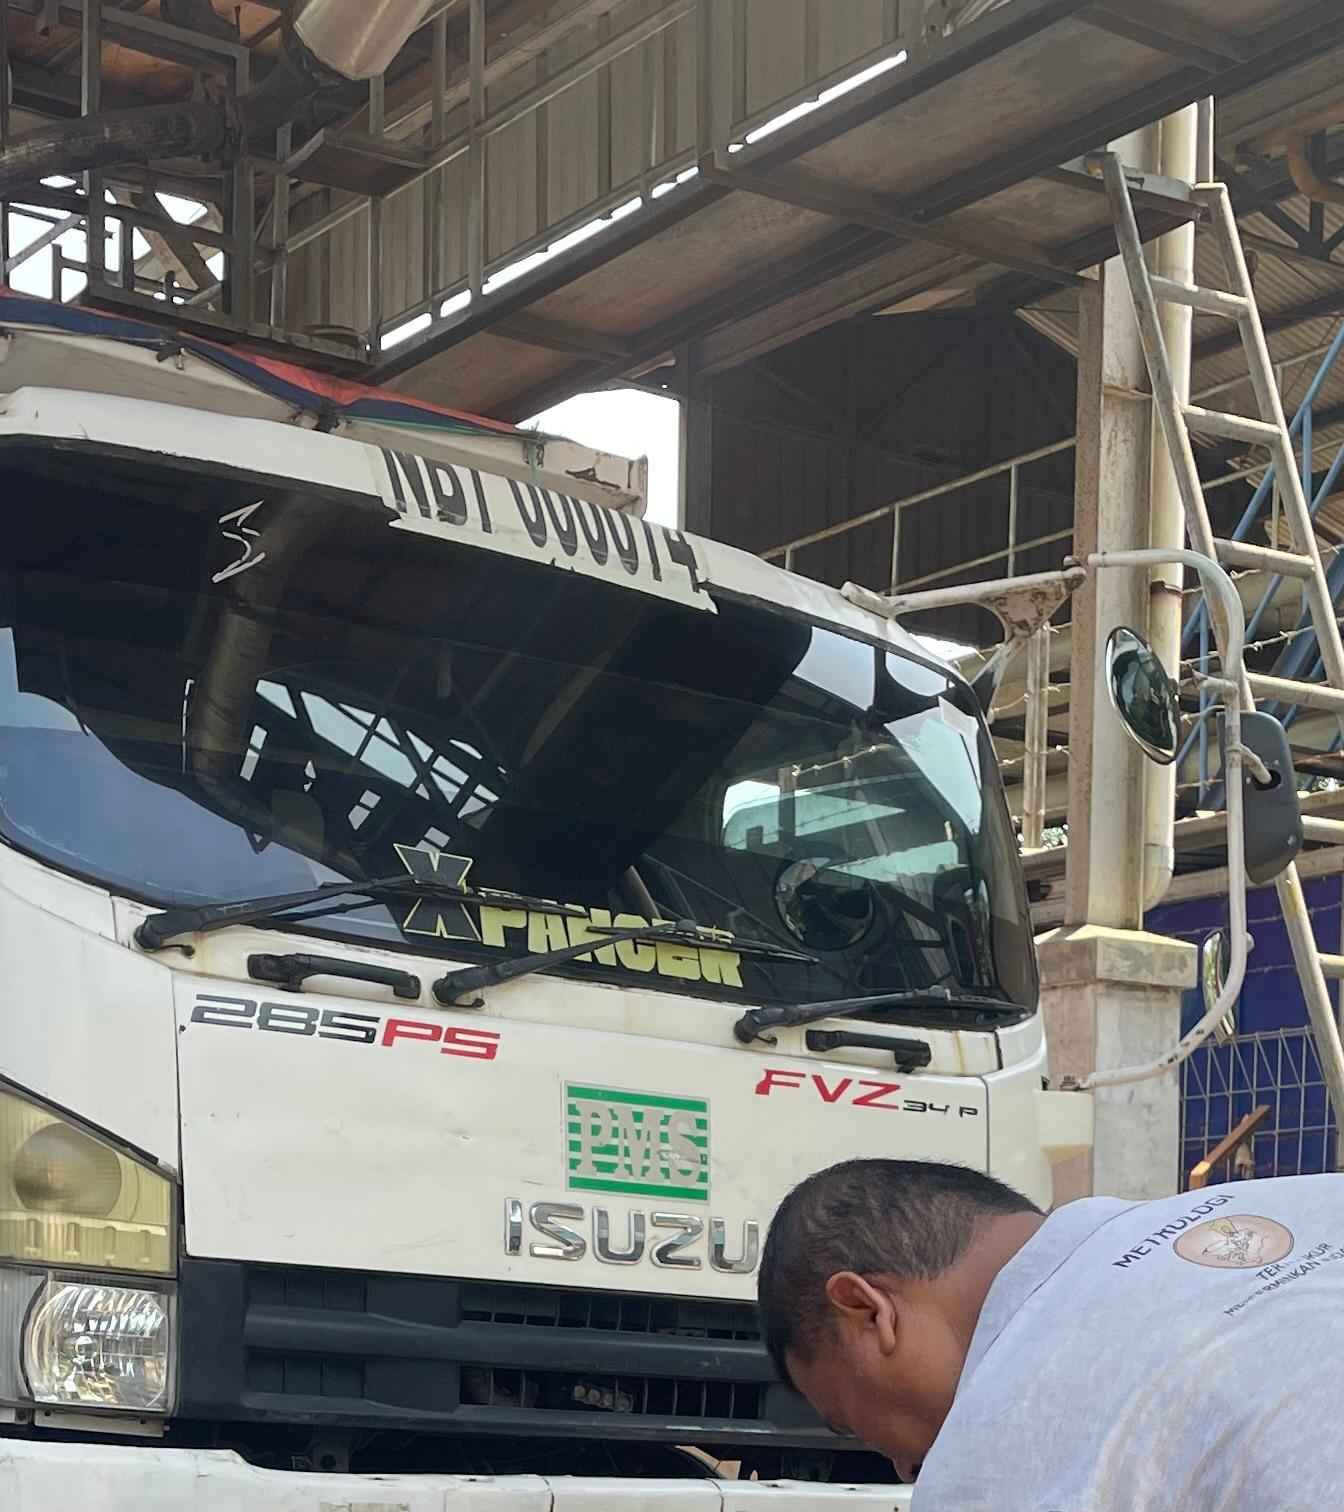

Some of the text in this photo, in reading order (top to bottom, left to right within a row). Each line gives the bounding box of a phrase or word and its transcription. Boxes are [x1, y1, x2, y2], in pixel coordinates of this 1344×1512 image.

[190, 993, 501, 1061] 285PS
[755, 1068, 902, 1111] FVZ
[576, 1101, 703, 1186] PMS
[504, 1197, 760, 1276] ISUZU
